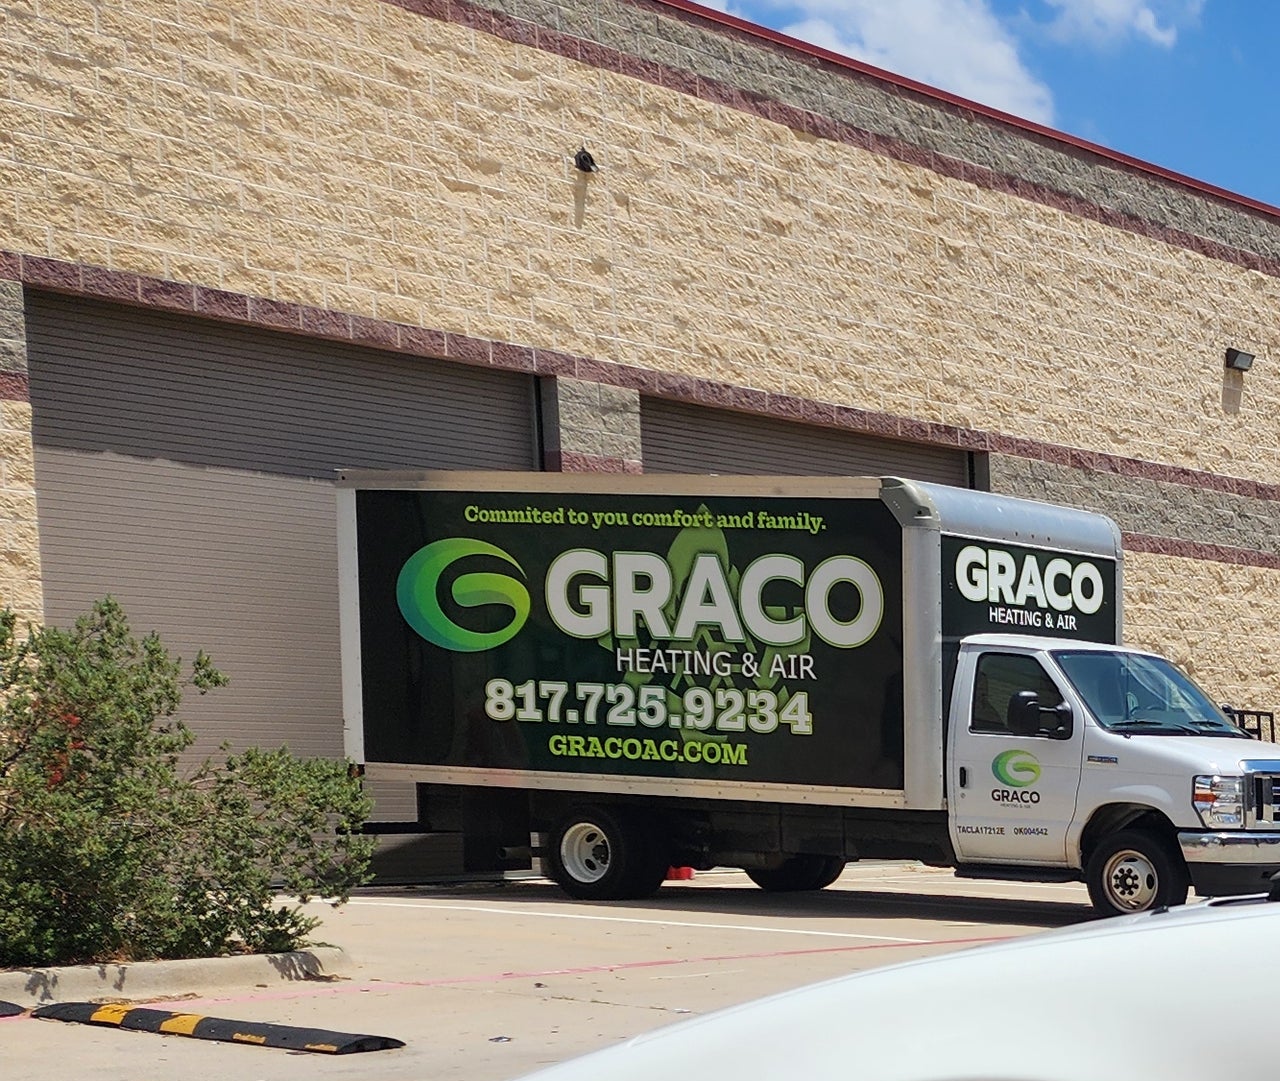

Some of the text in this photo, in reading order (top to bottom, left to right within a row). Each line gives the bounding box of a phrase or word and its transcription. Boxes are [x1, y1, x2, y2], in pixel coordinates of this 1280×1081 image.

[464, 505, 827, 535] Commited to you comfort and family.
[955, 545, 1104, 615] GRACO
[545, 548, 885, 648] GRACO
[990, 606, 1077, 631] HEATING & AIR
[616, 647, 818, 680] HEATING & AIR
[484, 678, 813, 735] 817.725.9234
[549, 734, 749, 765] GRACOAC.COM
[991, 788, 1041, 804] GRACO
